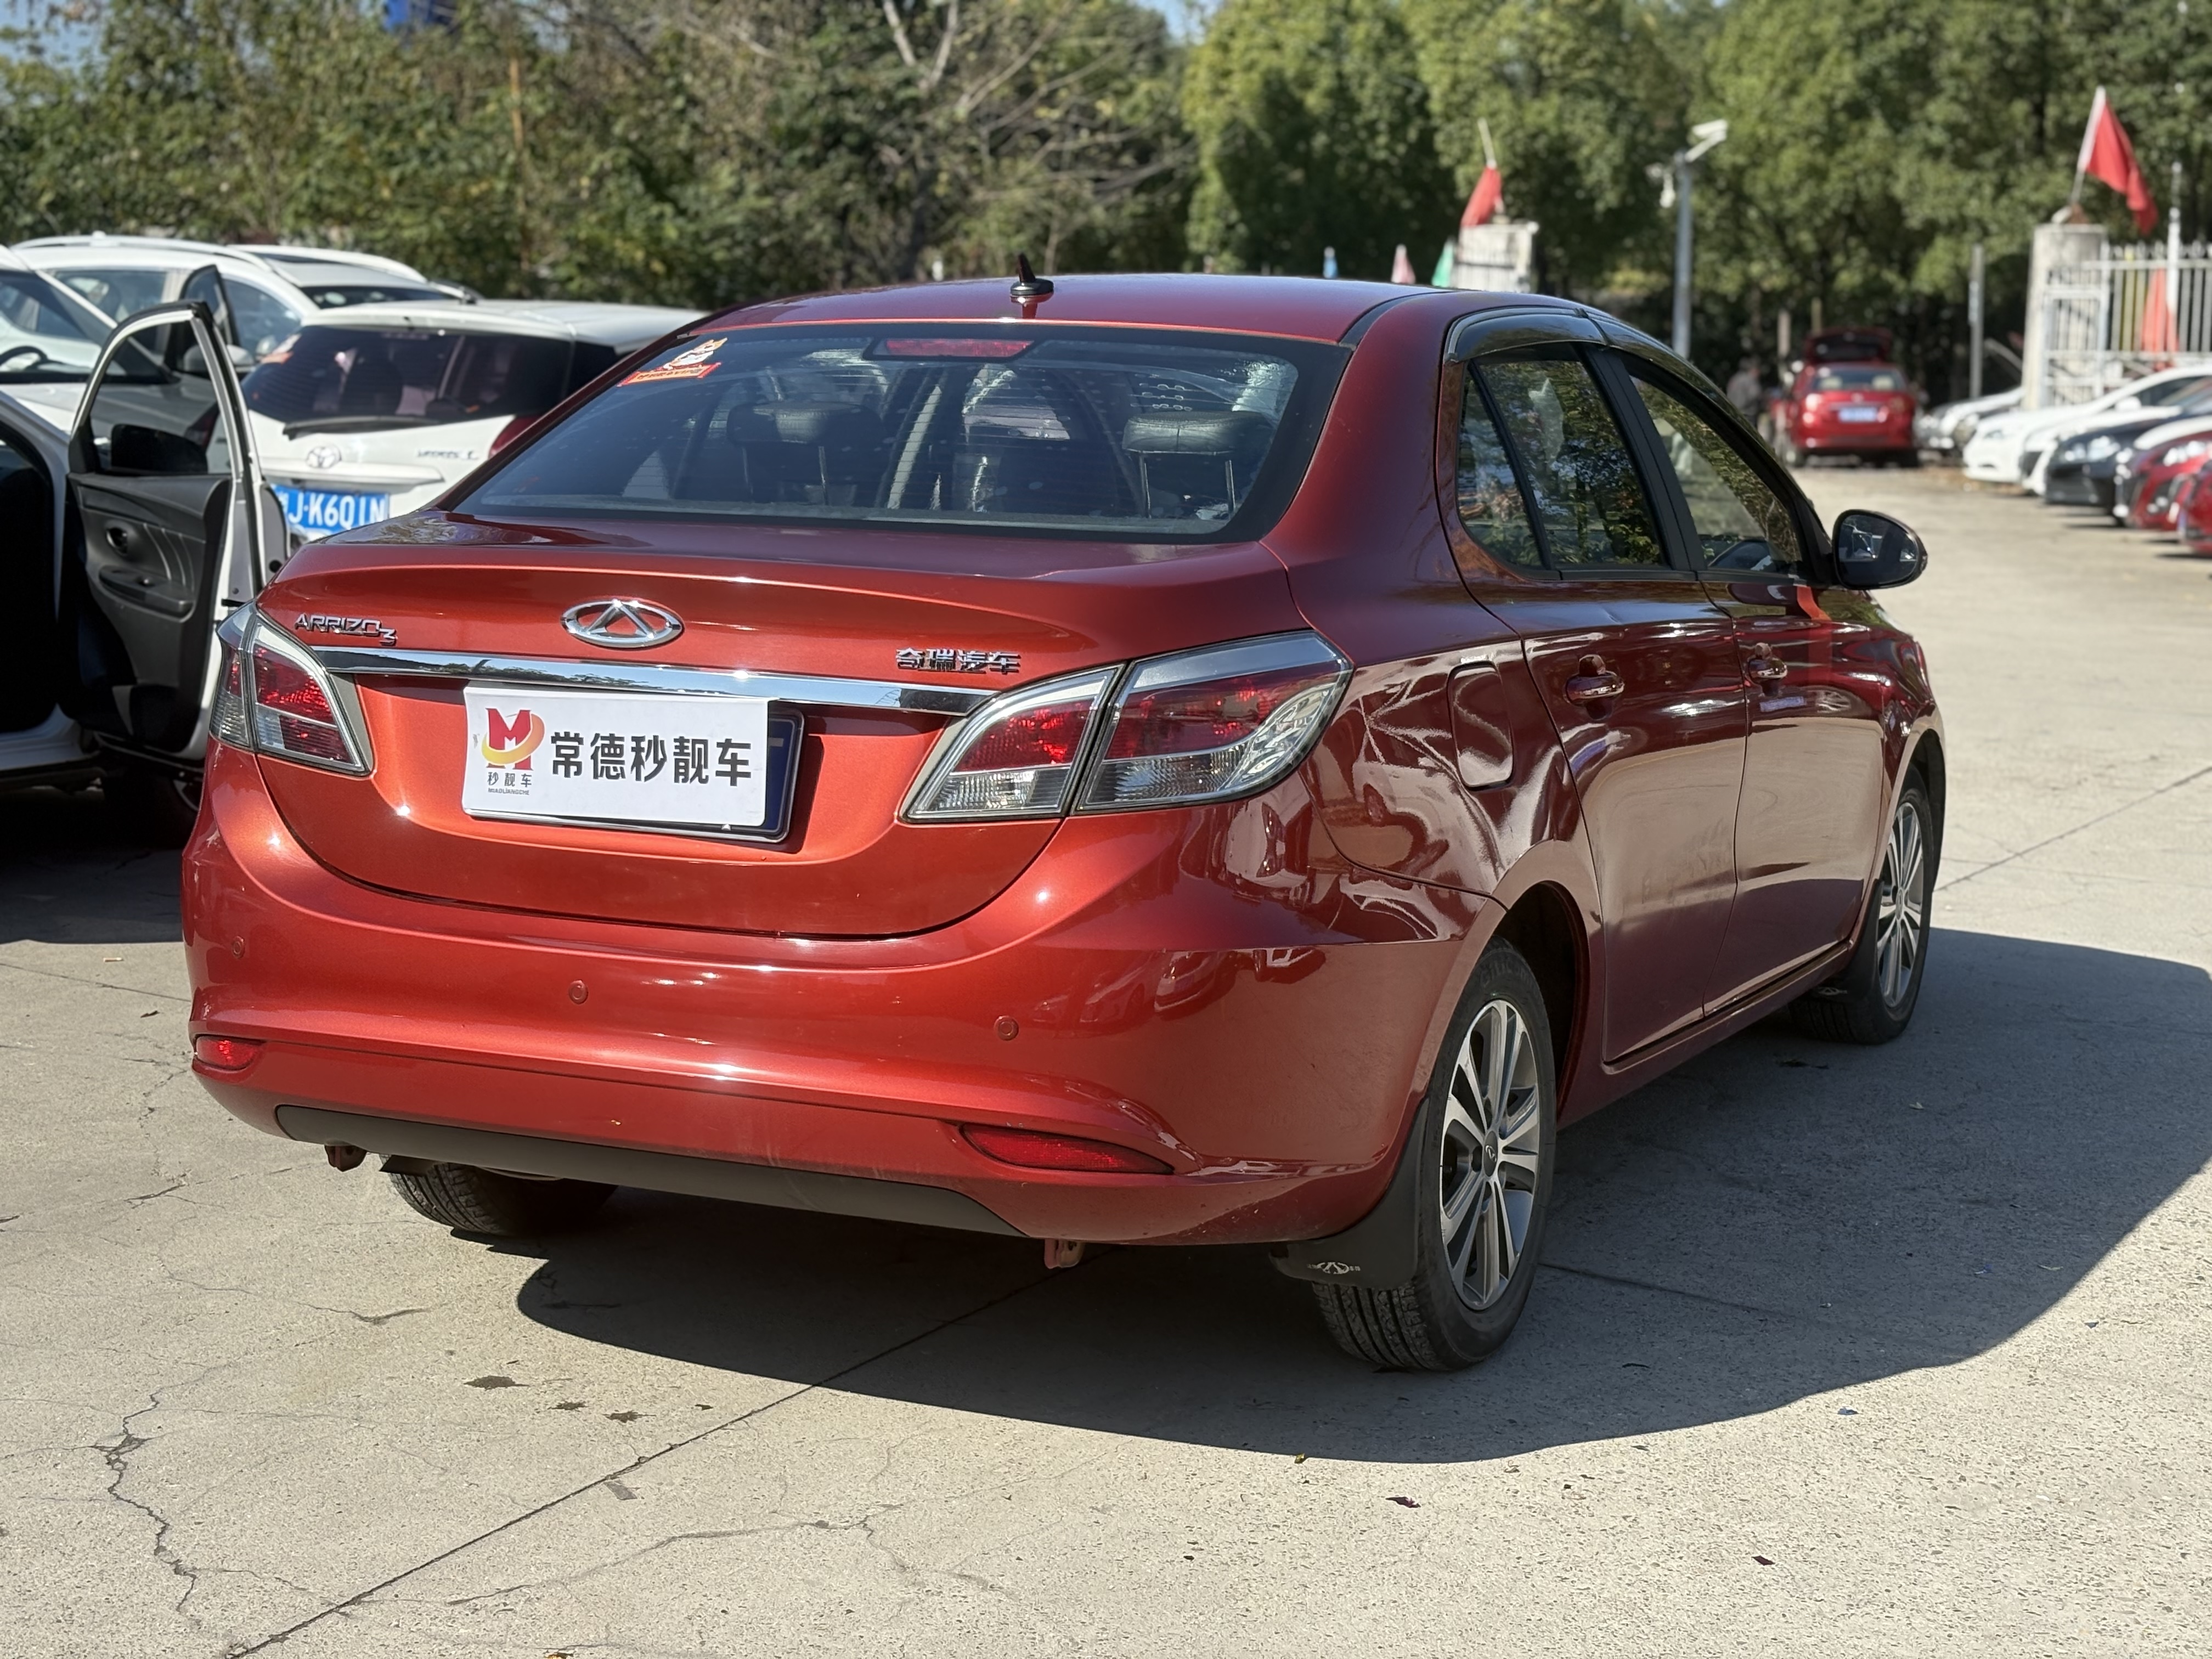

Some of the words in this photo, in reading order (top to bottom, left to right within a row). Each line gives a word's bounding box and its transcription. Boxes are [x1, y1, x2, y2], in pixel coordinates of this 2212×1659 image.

[295, 612, 383, 637] ARRIZO
[896, 647, 1022, 675] 奇瑞汽车
[550, 731, 752, 787] 常德秒靓车
[487, 771, 532, 788] 秒靓车
